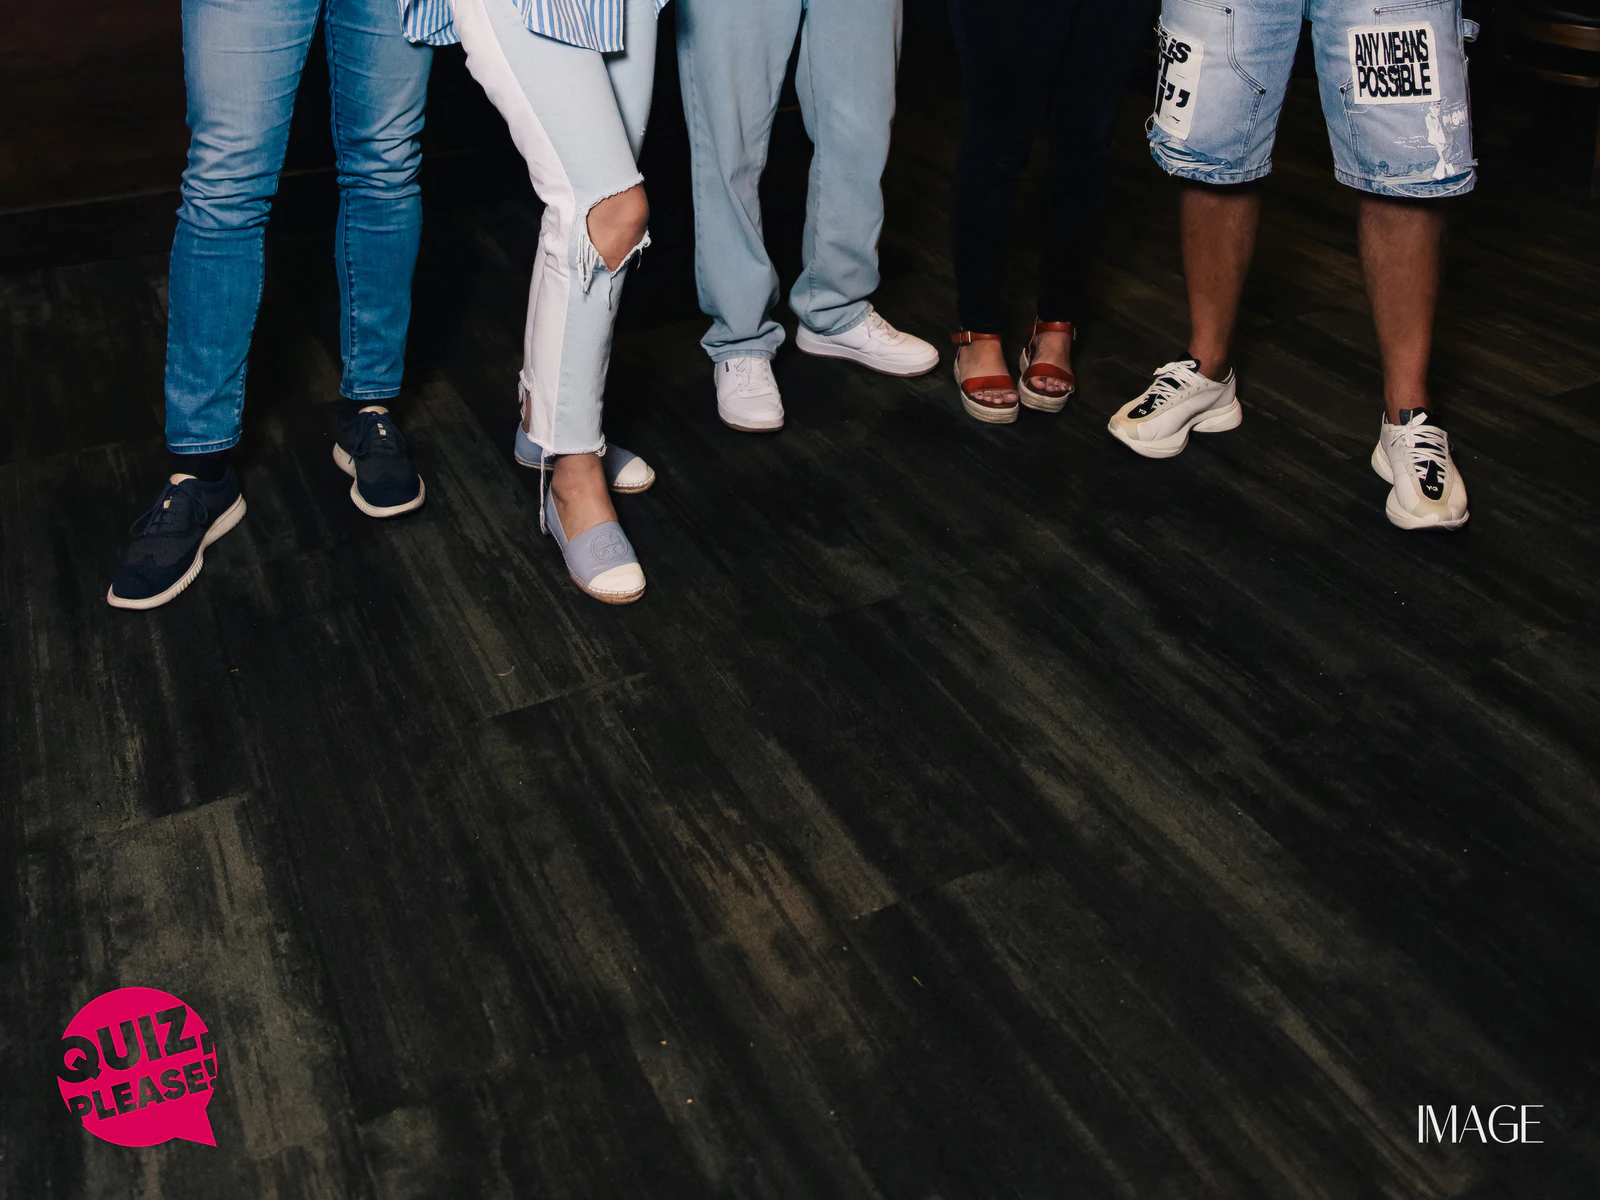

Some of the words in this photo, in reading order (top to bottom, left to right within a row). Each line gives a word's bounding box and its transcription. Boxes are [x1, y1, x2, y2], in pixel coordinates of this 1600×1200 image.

[1355, 32, 1379, 66] ANY
[1381, 29, 1429, 65] MEANS
[1357, 63, 1432, 98] POSSIBLE
